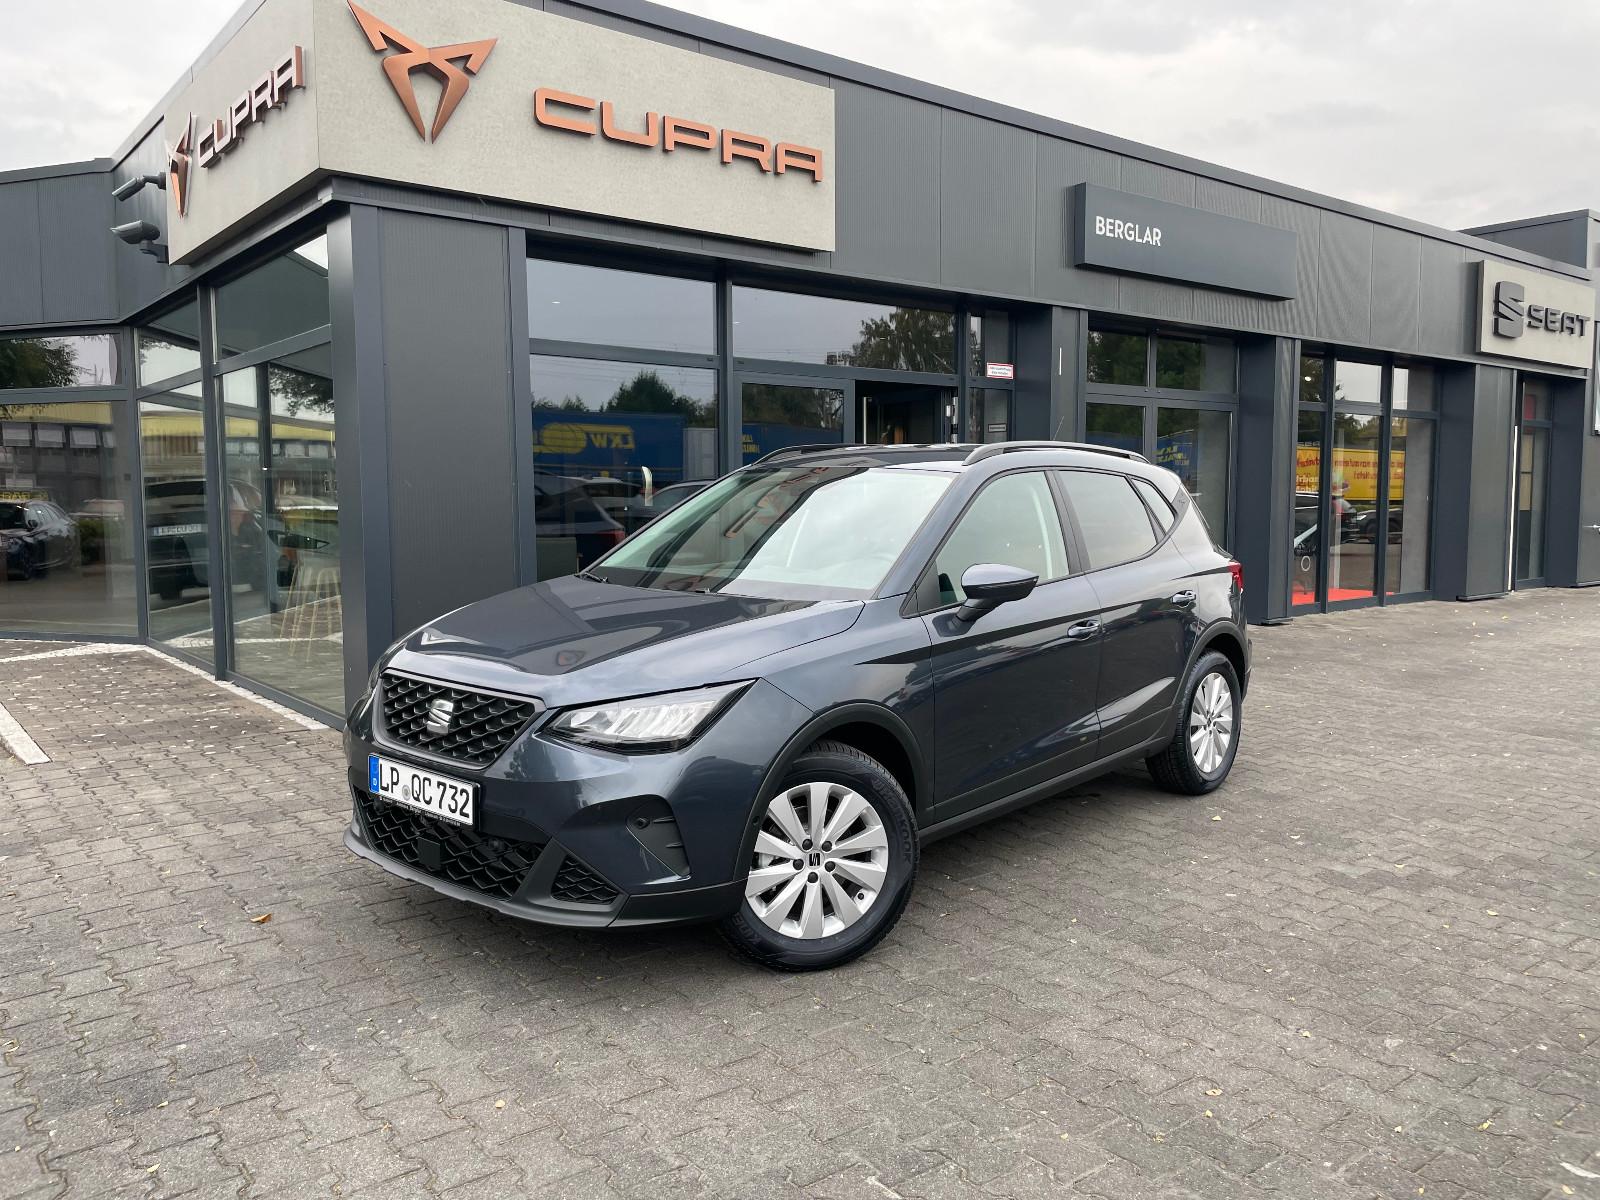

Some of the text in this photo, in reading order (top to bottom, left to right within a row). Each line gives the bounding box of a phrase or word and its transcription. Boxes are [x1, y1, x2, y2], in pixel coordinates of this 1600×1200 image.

[198, 45, 304, 168] CUPRA
[534, 87, 823, 182] CUPRA
[1095, 215, 1162, 247] BERGLAR
[1527, 304, 1591, 337] SEAT
[380, 763, 400, 794] LP
[411, 773, 433, 806] QC
[437, 781, 470, 819] 732
